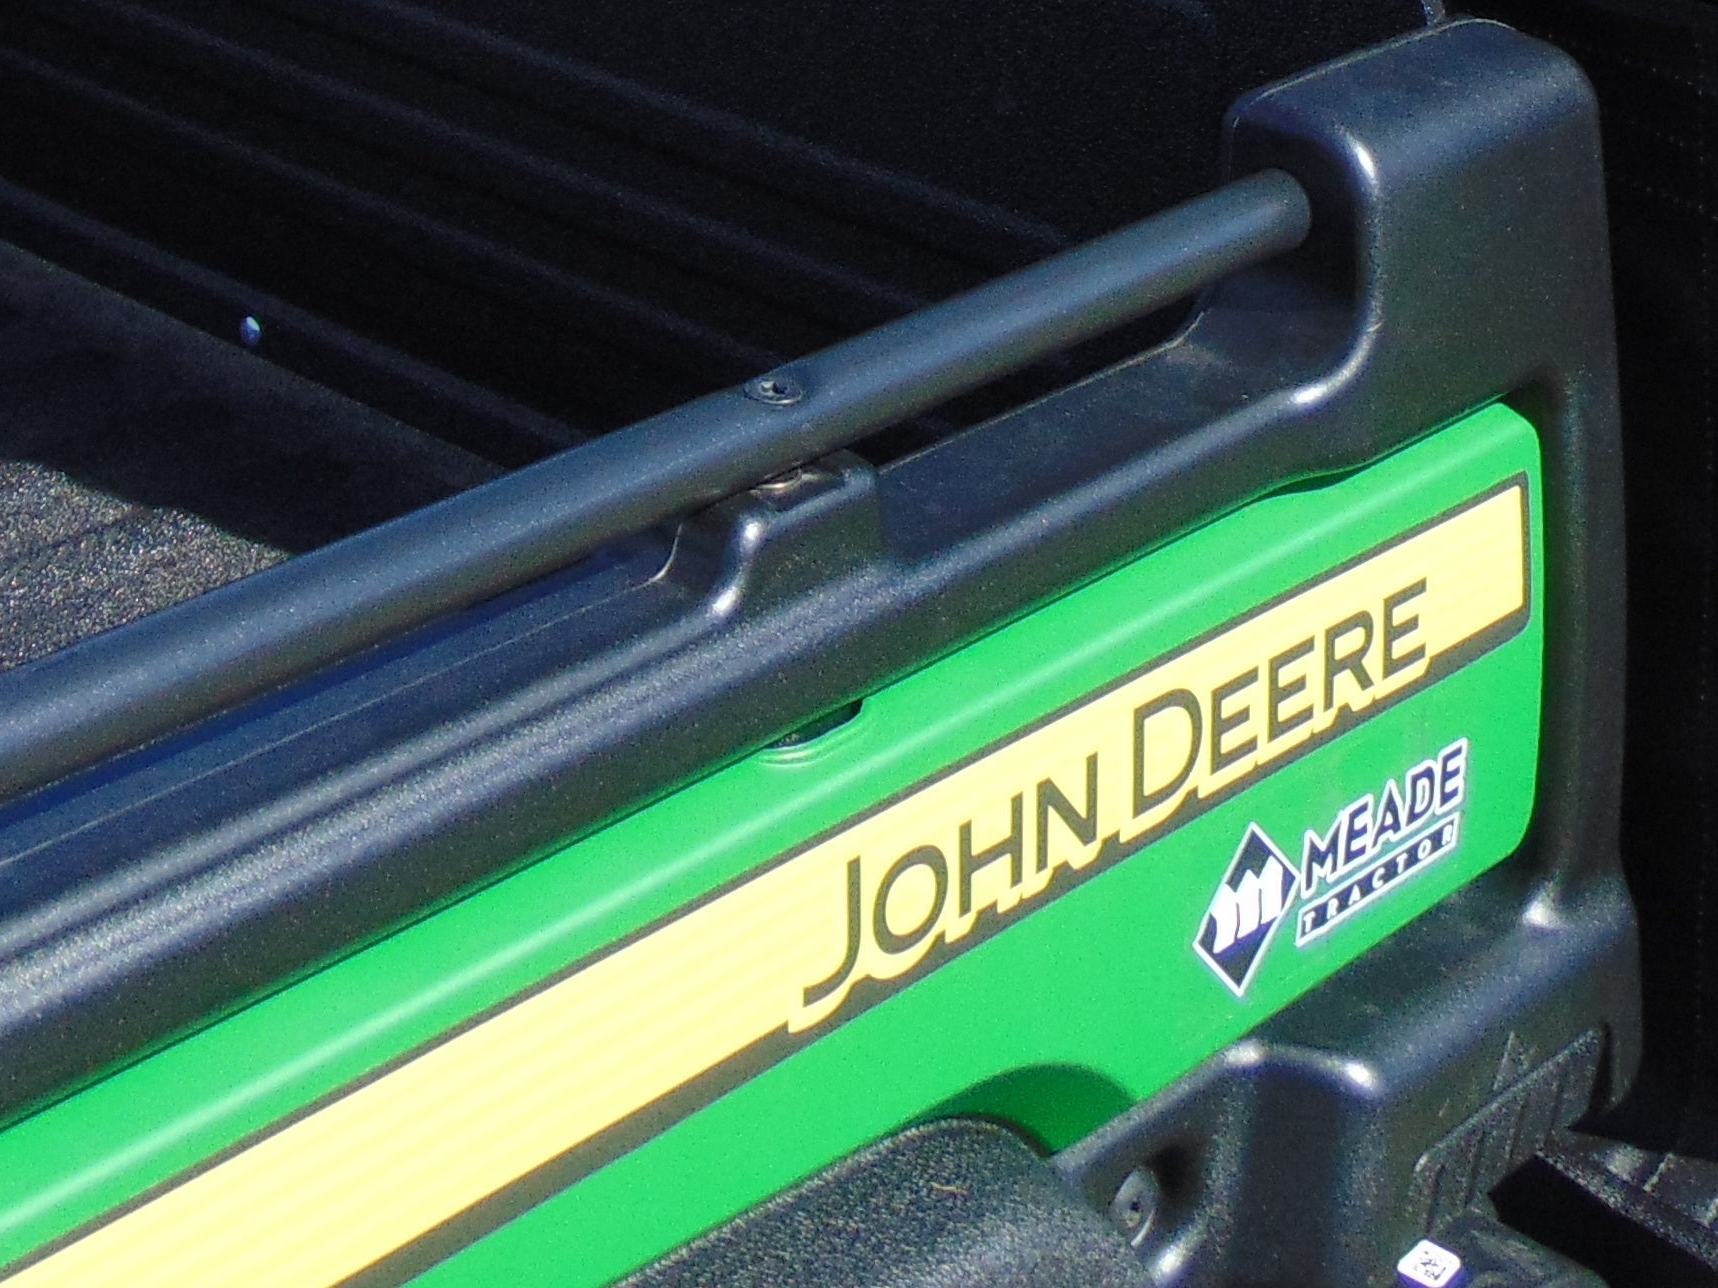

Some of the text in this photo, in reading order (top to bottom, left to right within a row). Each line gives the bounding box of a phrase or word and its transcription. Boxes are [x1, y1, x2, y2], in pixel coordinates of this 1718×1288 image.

[802, 577, 1427, 1009] JOHN DEERE
[1304, 742, 1466, 894] MEADE
[1301, 820, 1458, 942] TRACTOR
